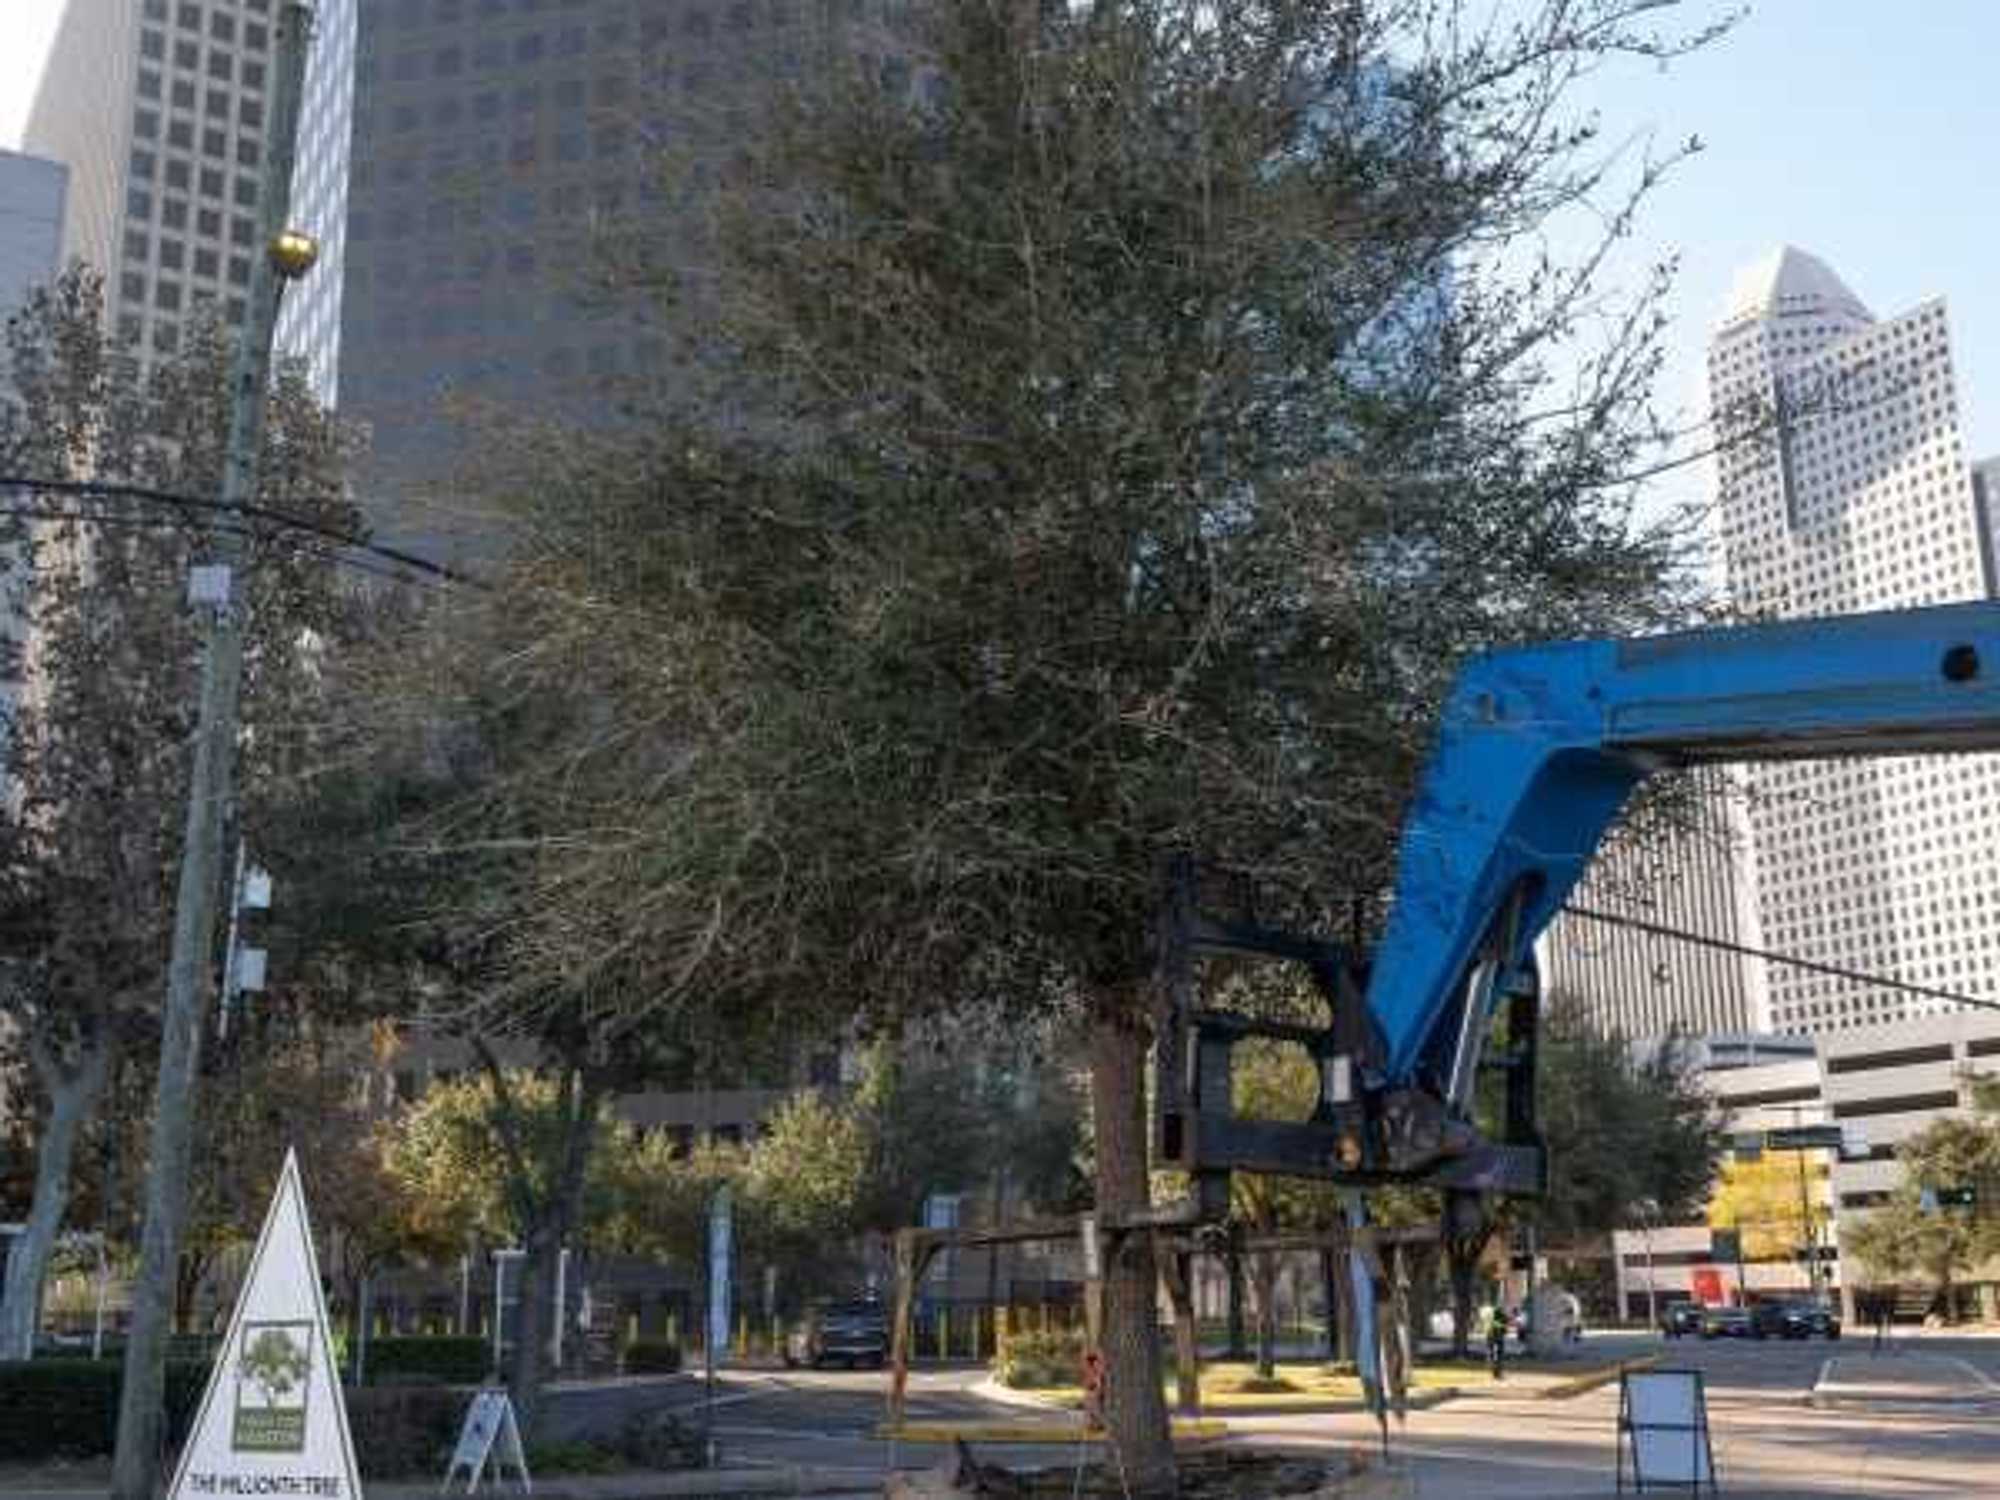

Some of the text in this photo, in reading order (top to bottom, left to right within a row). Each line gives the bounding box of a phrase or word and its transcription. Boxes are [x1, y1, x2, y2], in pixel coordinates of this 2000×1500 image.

[190, 1473, 341, 1496] THE MILLIONTH TREE
